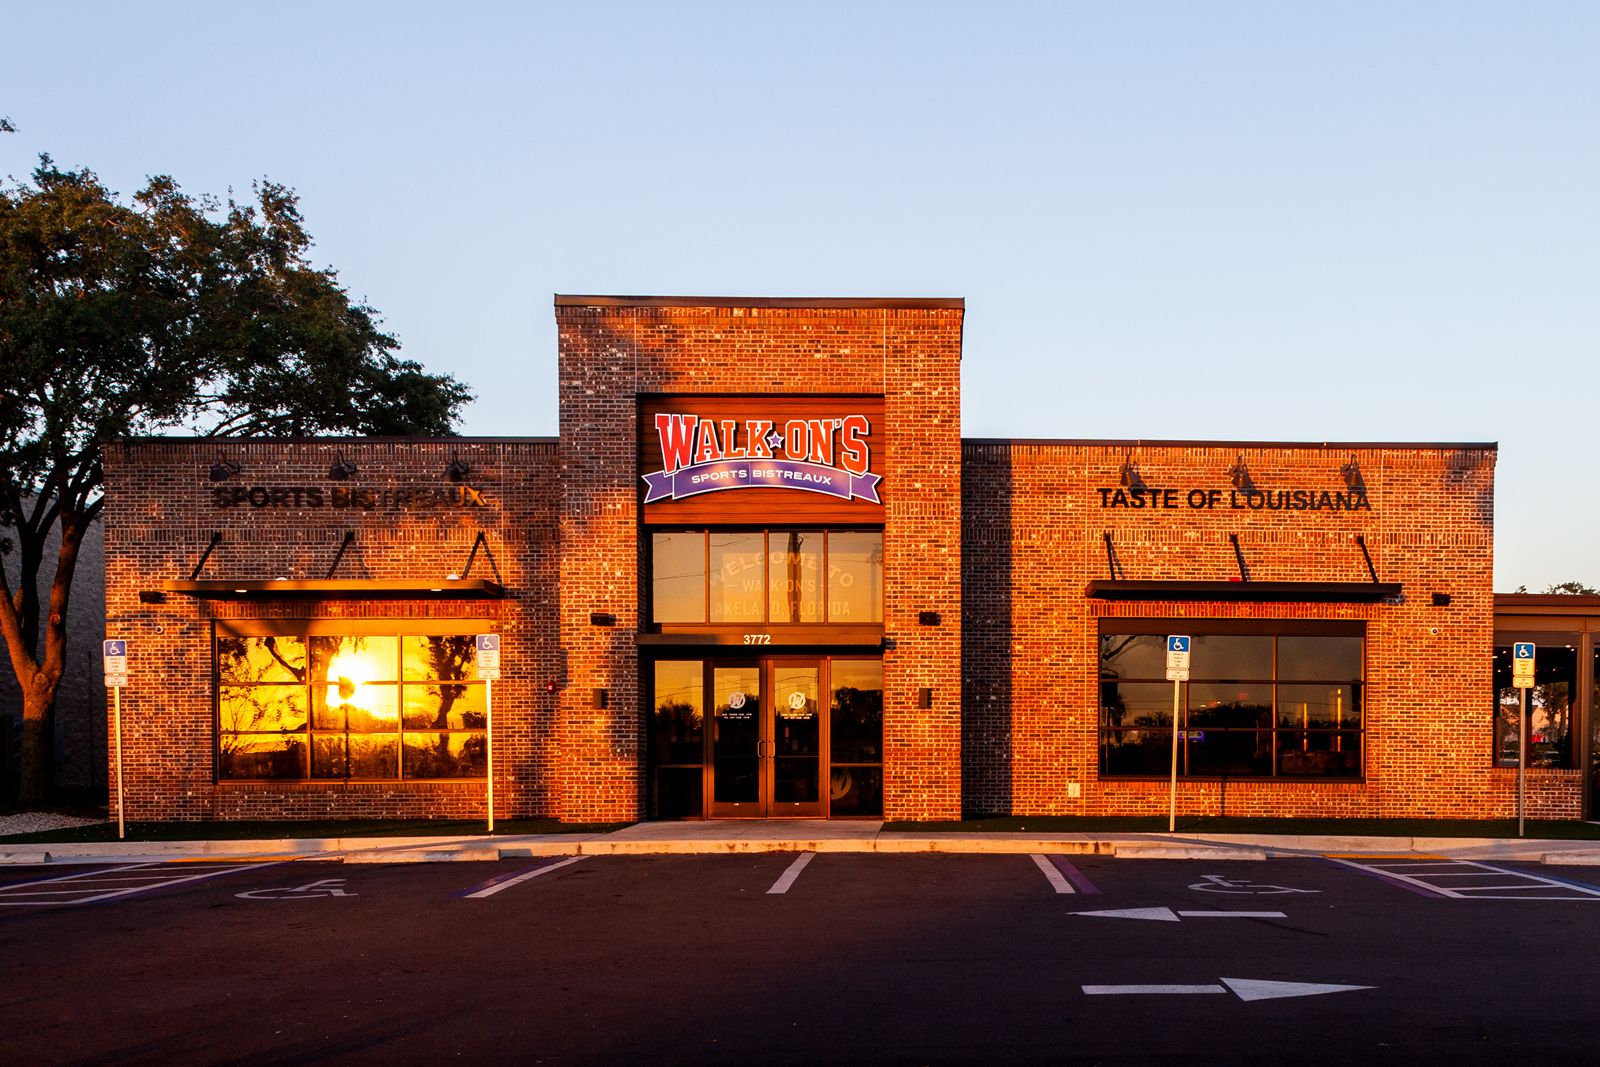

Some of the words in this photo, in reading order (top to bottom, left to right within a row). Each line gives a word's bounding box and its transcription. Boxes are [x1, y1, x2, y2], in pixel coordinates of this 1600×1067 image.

[691, 469, 748, 485] SPORTS
[752, 469, 833, 486] BISTREAUX
[213, 486, 324, 508] SPORTS
[331, 486, 486, 508] BISTREAUX
[1097, 488, 1179, 509] TASTE
[1187, 488, 1222, 509] OF
[1231, 489, 1372, 511] LOUISIANA
[829, 564, 855, 588] TO
[742, 579, 780, 593] WAK
[710, 600, 786, 617] AKELAD,
[743, 634, 771, 645] 3772
